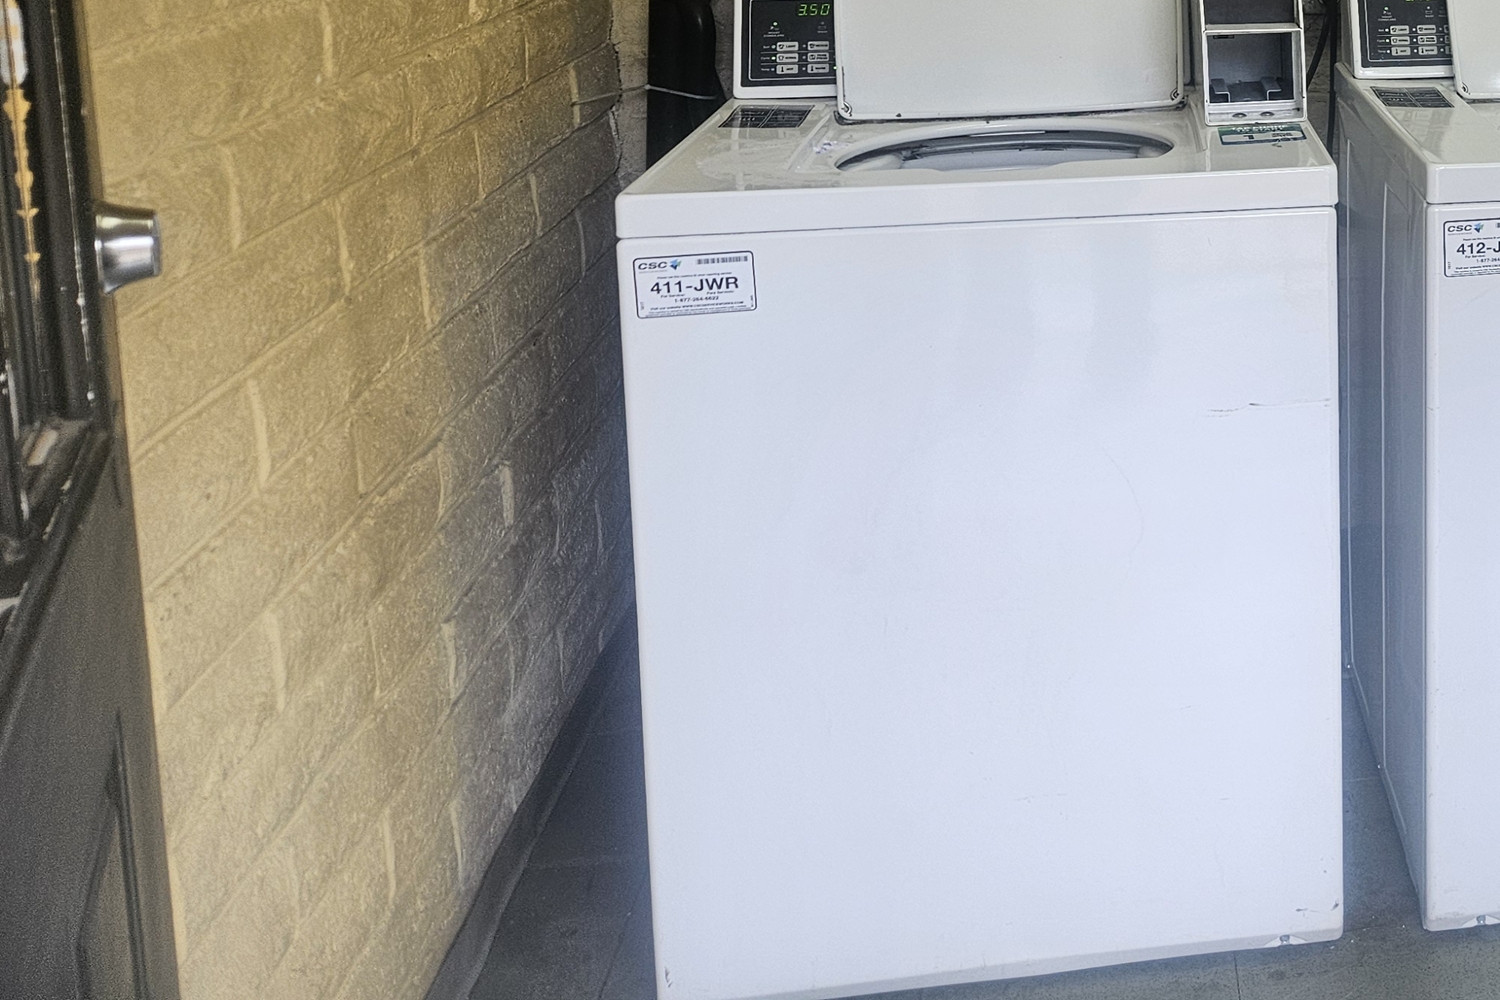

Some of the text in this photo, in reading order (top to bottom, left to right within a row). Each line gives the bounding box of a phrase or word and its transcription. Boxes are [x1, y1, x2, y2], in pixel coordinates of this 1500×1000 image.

[798, 3, 831, 16] 3.50
[1447, 224, 1473, 233] CSC
[637, 261, 668, 271] CSC
[650, 276, 739, 295] 411-JWR
